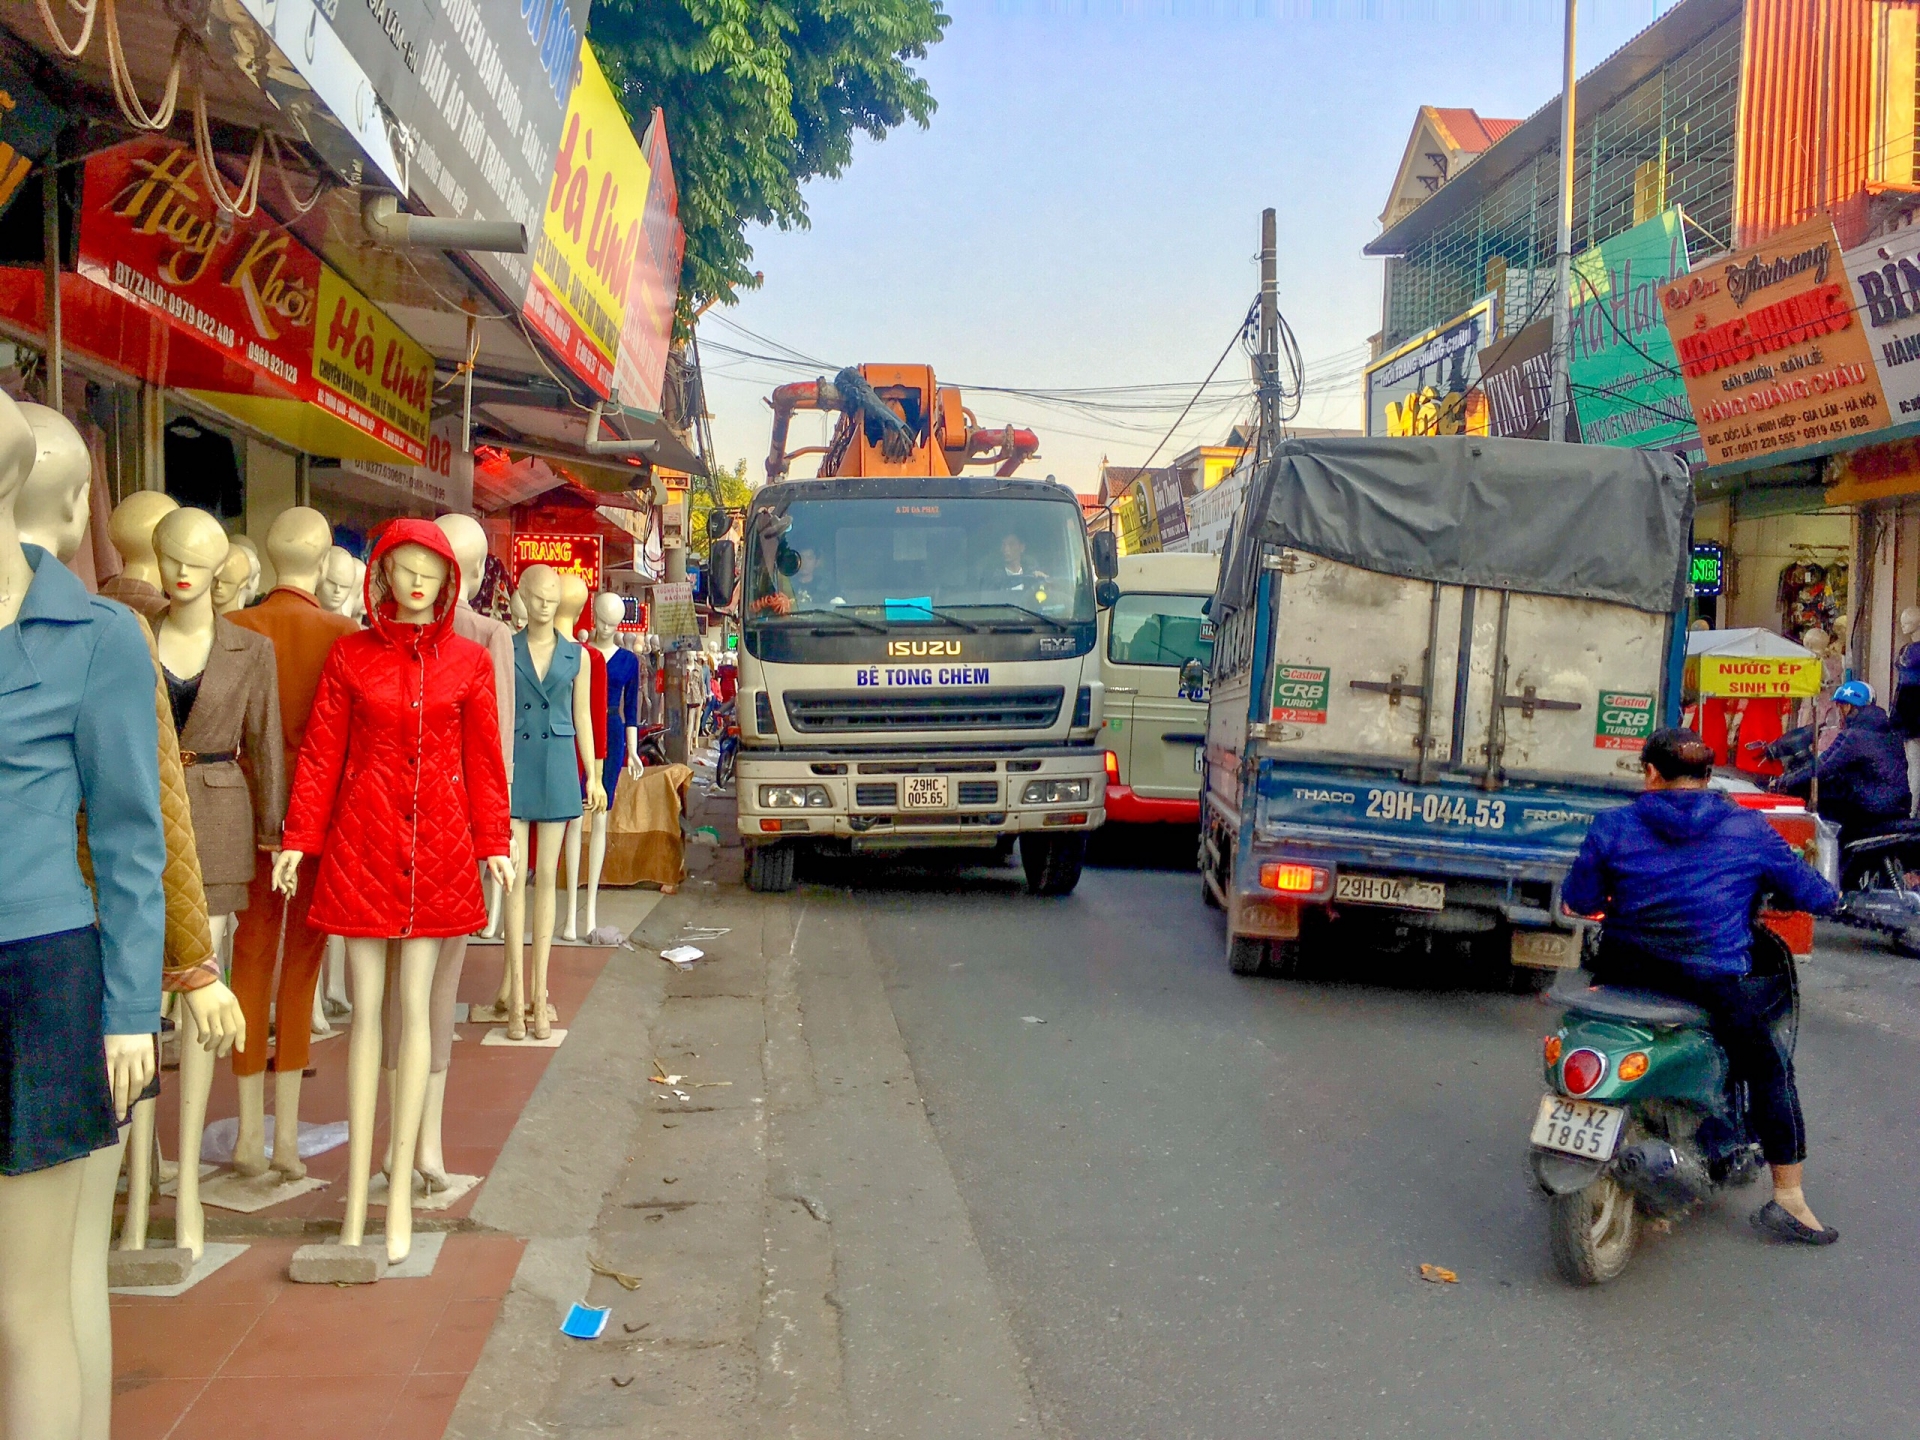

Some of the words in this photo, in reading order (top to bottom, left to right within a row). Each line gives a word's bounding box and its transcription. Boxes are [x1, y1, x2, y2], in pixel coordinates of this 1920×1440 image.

[478, 36, 503, 101] BÁN
[496, 71, 525, 139] BUÔN
[521, 120, 544, 172] BÁN
[443, 73, 465, 132] ÁO
[458, 100, 486, 165] THỜI
[480, 134, 511, 203] TRANG
[114, 147, 223, 285] Huy
[1747, 283, 1853, 356] NHUNG
[168, 292, 196, 326] 0979
[197, 309, 216, 337] 022
[216, 321, 235, 349] 408
[248, 341, 270, 368] 0968
[269, 352, 284, 377] 921
[285, 363, 299, 385] 128
[328, 296, 375, 376] Hà
[1395, 356, 1420, 380] TRANG
[1722, 372, 1743, 392] BÁN
[1743, 363, 1775, 387] BUÔN
[1782, 353, 1805, 373] BÁN
[1487, 364, 1529, 438] TING
[1802, 407, 1818, 423] GIA
[1760, 437, 1778, 451] 220
[1780, 433, 1796, 448] 555
[1830, 419, 1848, 434] 451
[519, 541, 572, 562] TRANG
[888, 641, 961, 656] ISUZU
[857, 665, 880, 687] BÊ
[938, 664, 990, 685] CHÈM
[1291, 670, 1323, 681] Castrol
[1719, 661, 1771, 676] NƯỚC
[1778, 658, 1803, 676] ÉP
[1279, 683, 1324, 699] CRB
[1729, 682, 1767, 694] SINH
[1614, 697, 1648, 708] Castrol
[1281, 709, 1297, 721] x2
[1602, 711, 1650, 727] CRB
[913, 778, 939, 792] 29HC
[1293, 788, 1356, 804] THACO
[908, 792, 943, 805] 005.65
[1366, 789, 1506, 829] 29H-044.53
[1547, 1123, 1602, 1153] 1865
